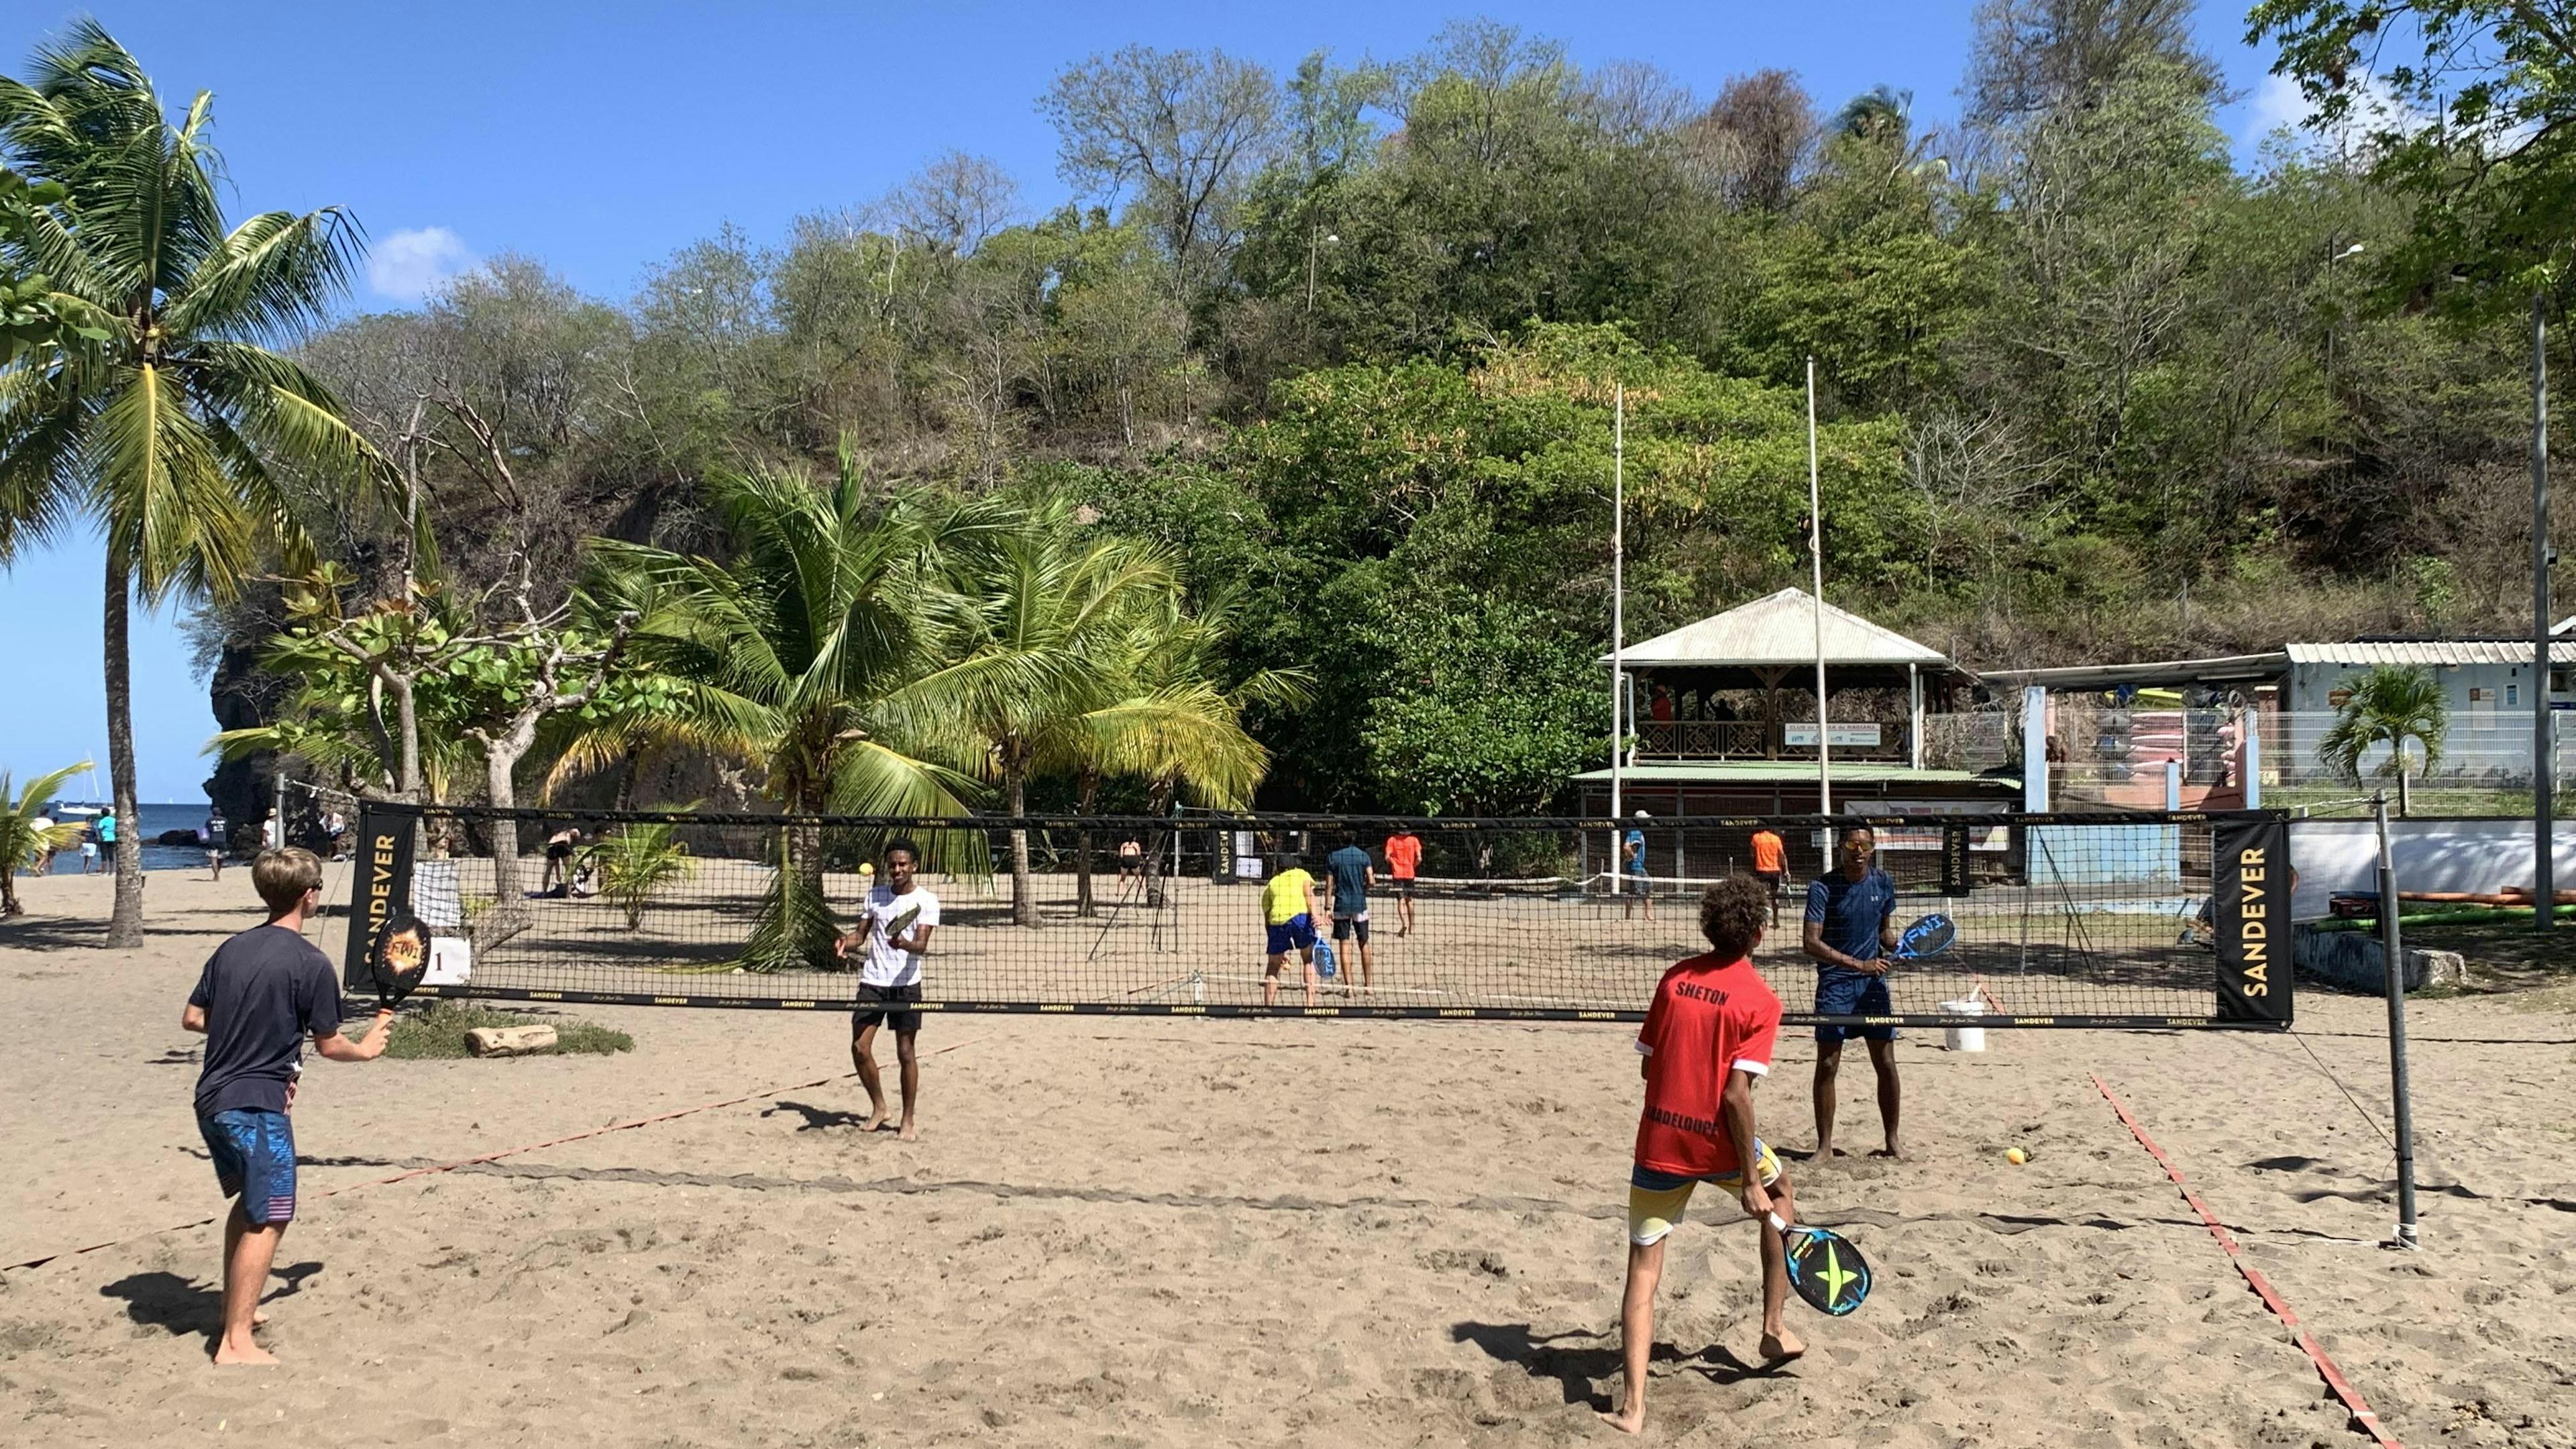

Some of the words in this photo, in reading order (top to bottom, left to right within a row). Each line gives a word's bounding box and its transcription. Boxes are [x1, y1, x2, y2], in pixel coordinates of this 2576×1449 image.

[1951, 831, 1962, 885] SANDEVER
[2241, 847, 2267, 997] SANDEVER
[435, 952, 442, 971] 1
[1675, 981, 1731, 1006] SHETON
[1578, 1011, 1616, 1019] SANDEVER
[2166, 1018, 2208, 1026] SANDEVER
